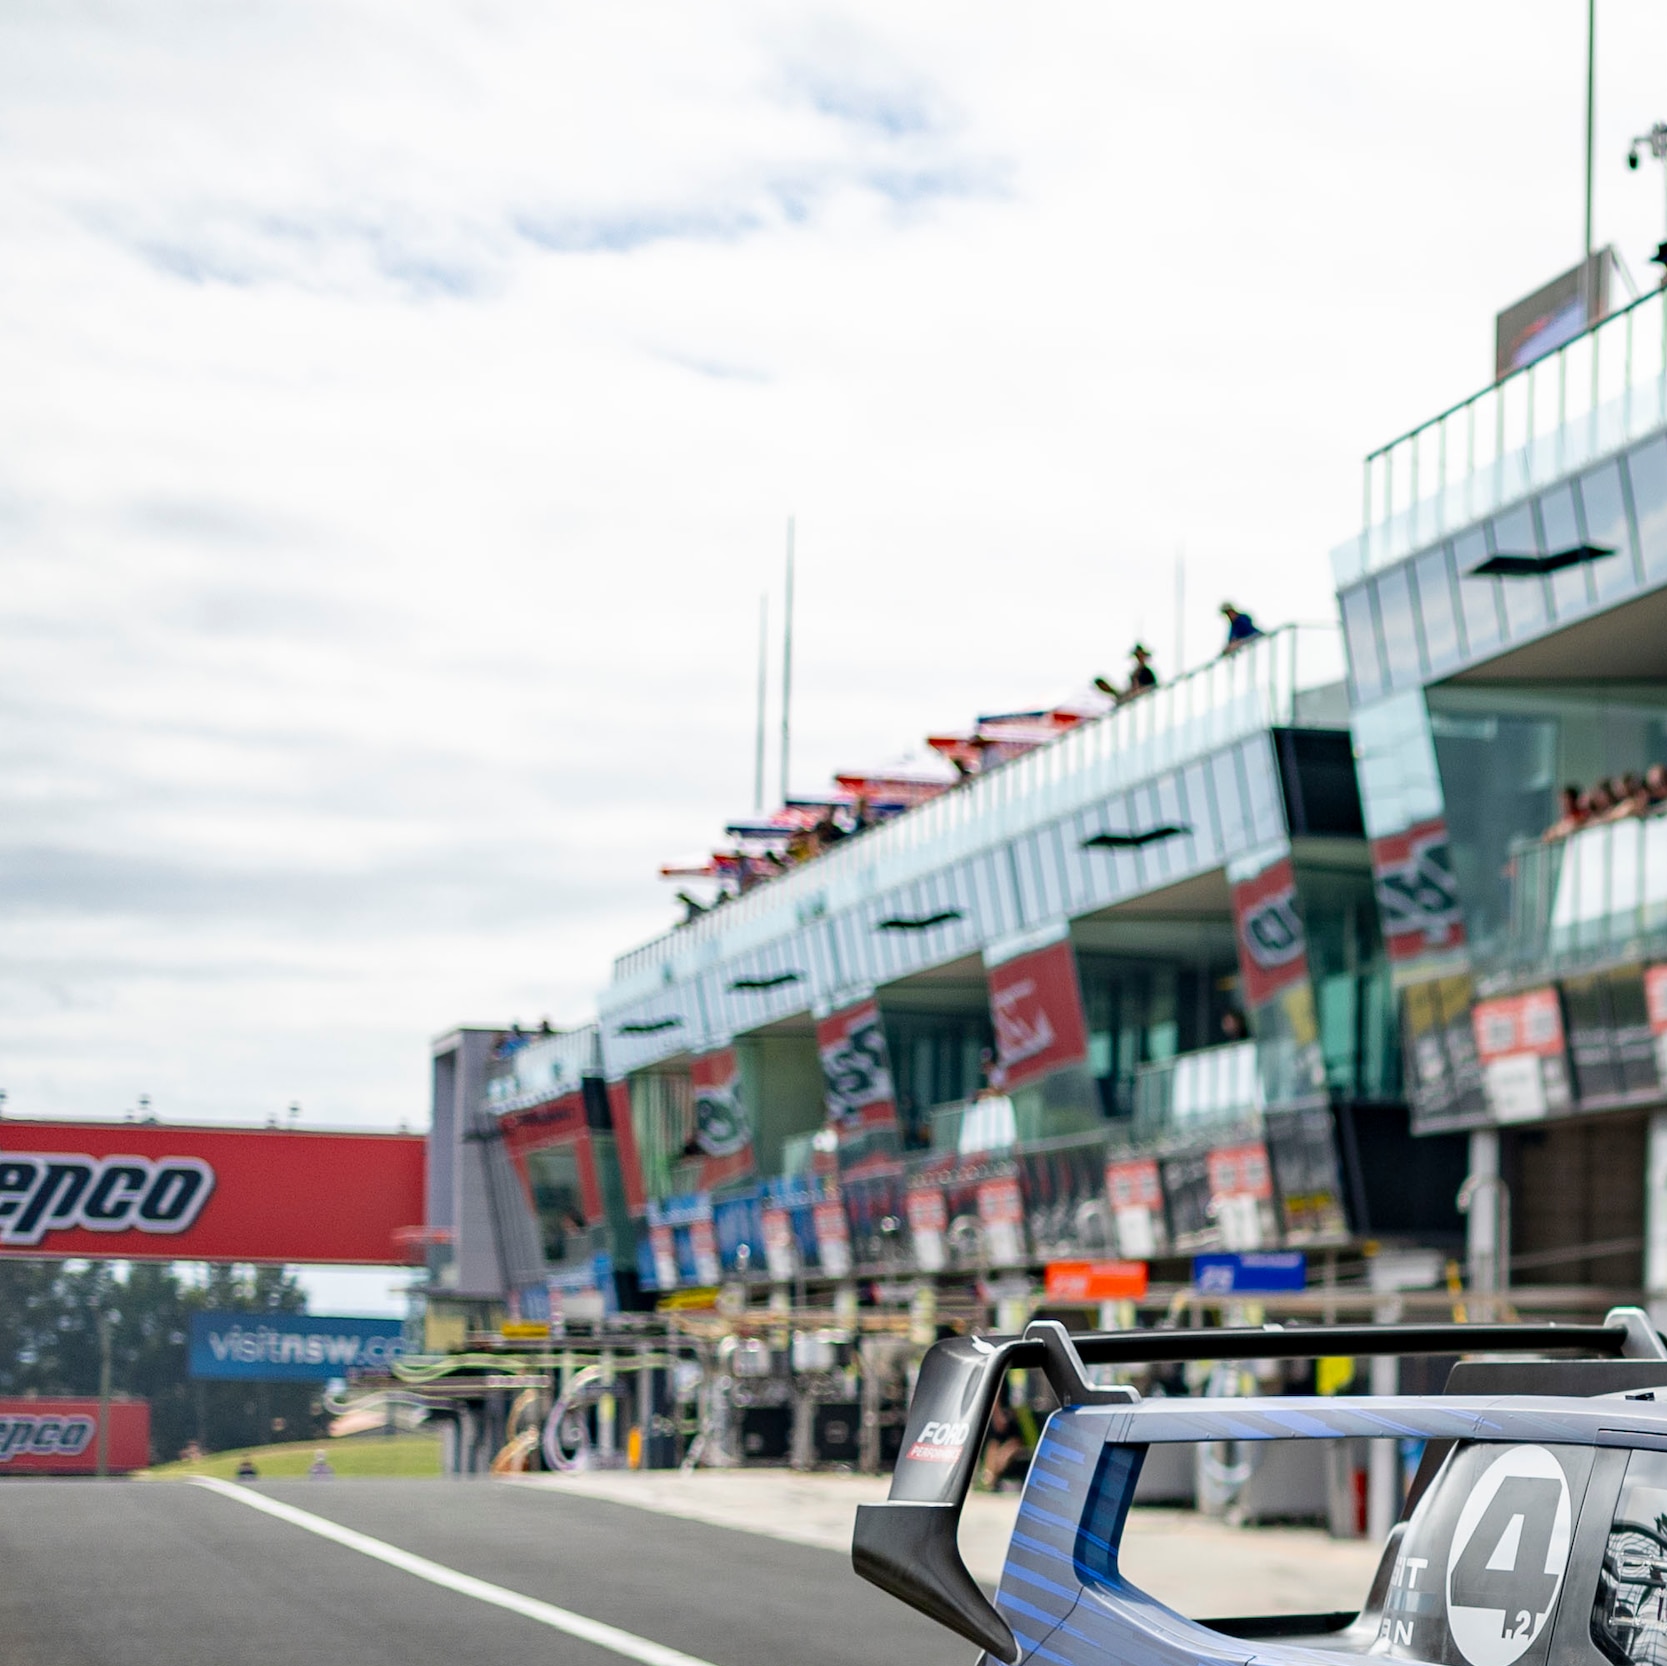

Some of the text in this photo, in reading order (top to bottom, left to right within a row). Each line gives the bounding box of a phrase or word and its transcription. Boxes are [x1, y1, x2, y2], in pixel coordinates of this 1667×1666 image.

[0, 1156, 209, 1240] epco
[210, 1325, 412, 1366] visitnsw.co
[917, 1421, 969, 1445] FORD
